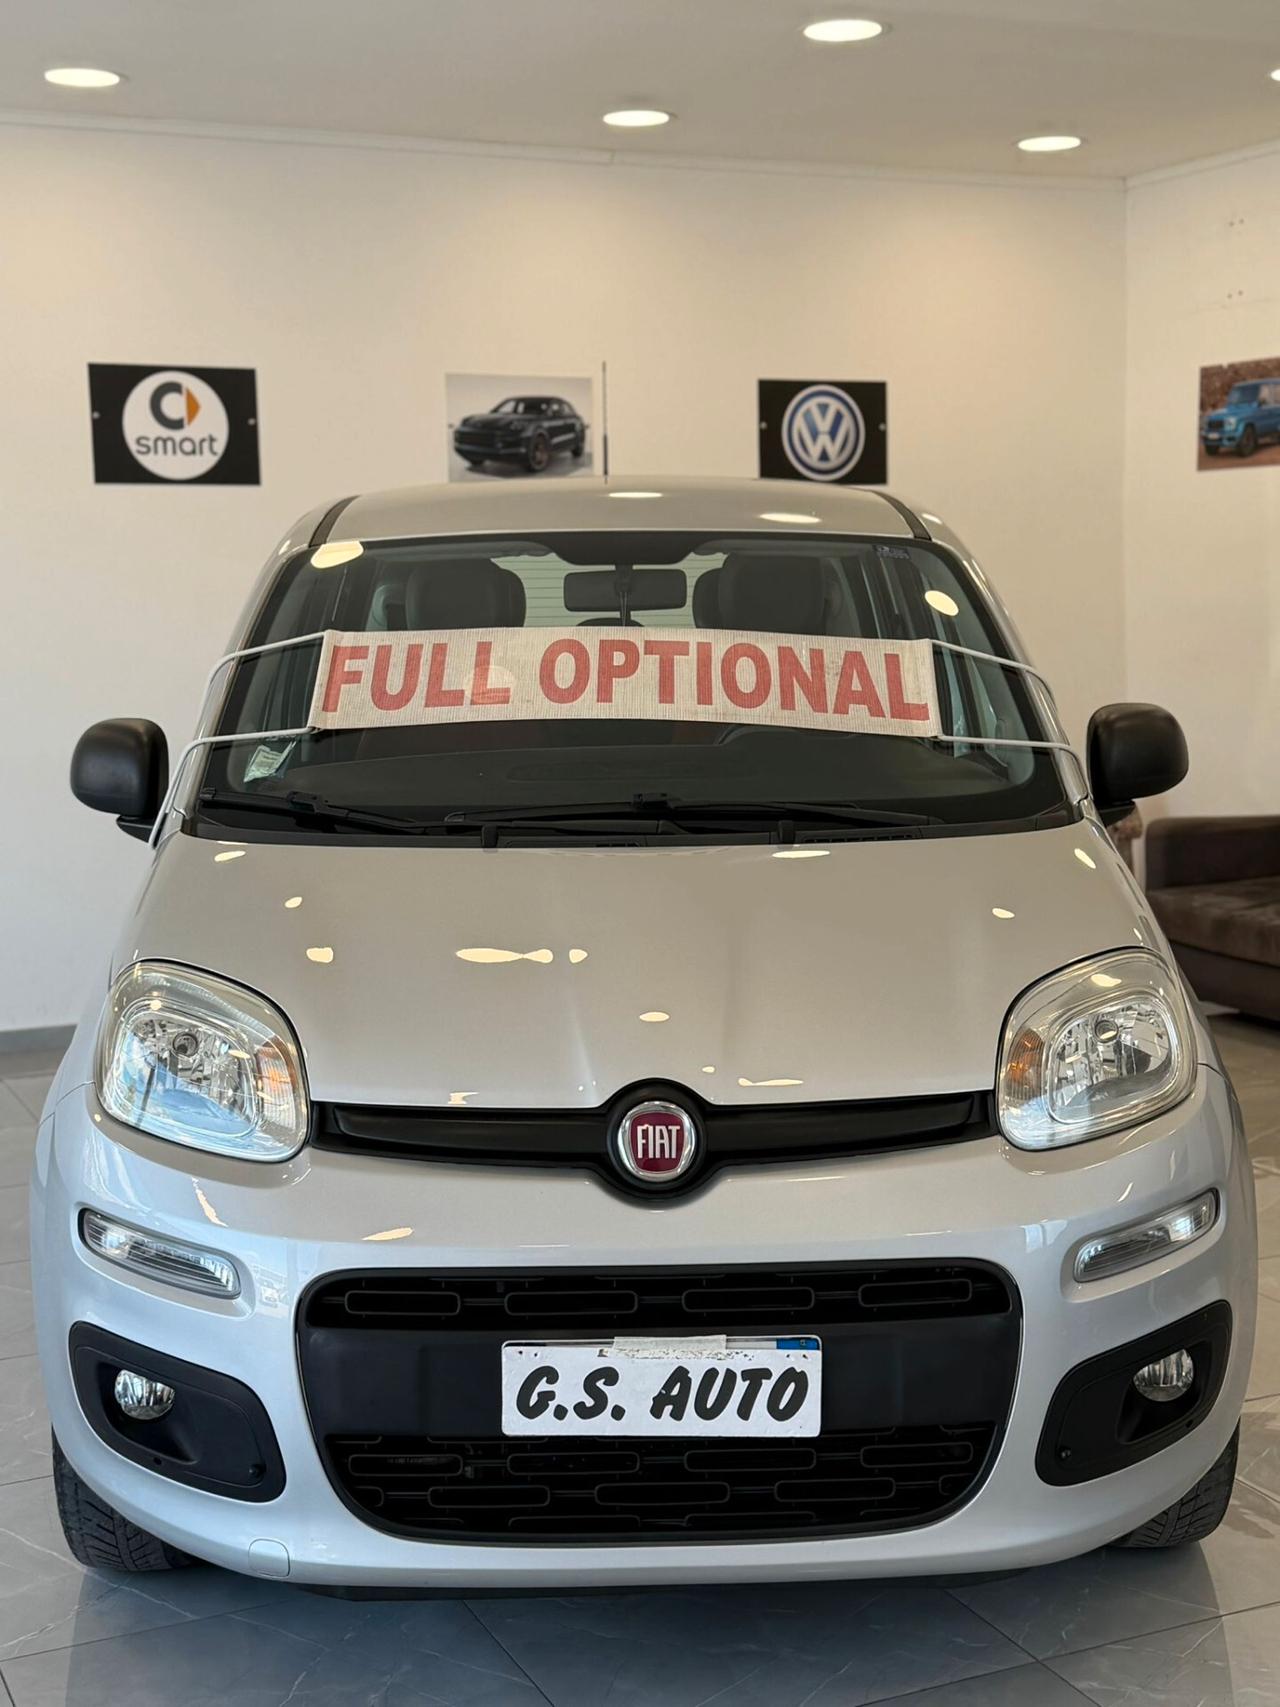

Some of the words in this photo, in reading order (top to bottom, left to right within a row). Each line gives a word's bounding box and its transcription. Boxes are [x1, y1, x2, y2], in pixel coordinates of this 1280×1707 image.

[135, 434, 218, 456] smart
[322, 641, 511, 712] FULL
[539, 638, 930, 721] OPTIONAL
[636, 1124, 681, 1159] FIAT
[516, 1365, 626, 1421] G.S.
[650, 1365, 809, 1422] AUTO
